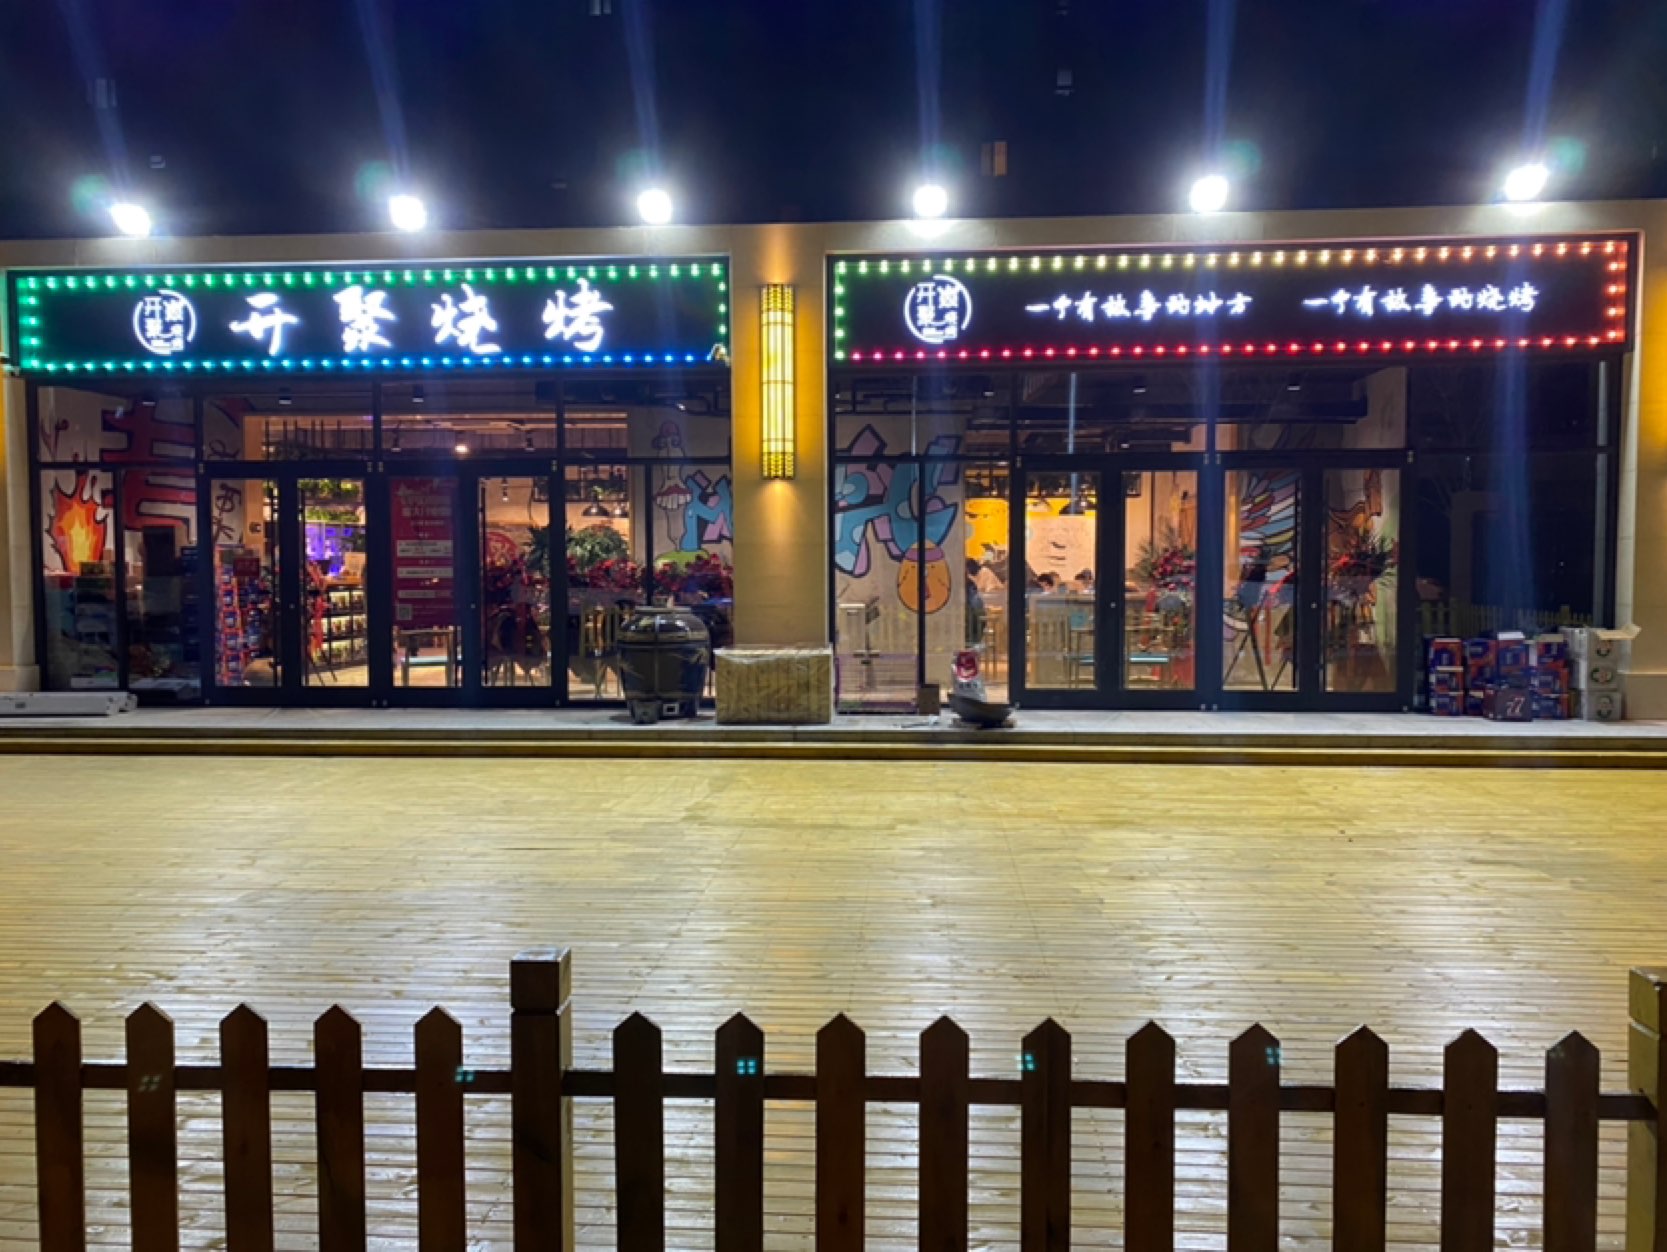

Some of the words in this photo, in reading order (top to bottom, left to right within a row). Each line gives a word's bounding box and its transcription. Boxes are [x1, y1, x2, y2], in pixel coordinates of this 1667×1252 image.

[228, 280, 614, 356] 开聚烧烤
[1302, 280, 1540, 318] 一个有故事的烧烤
